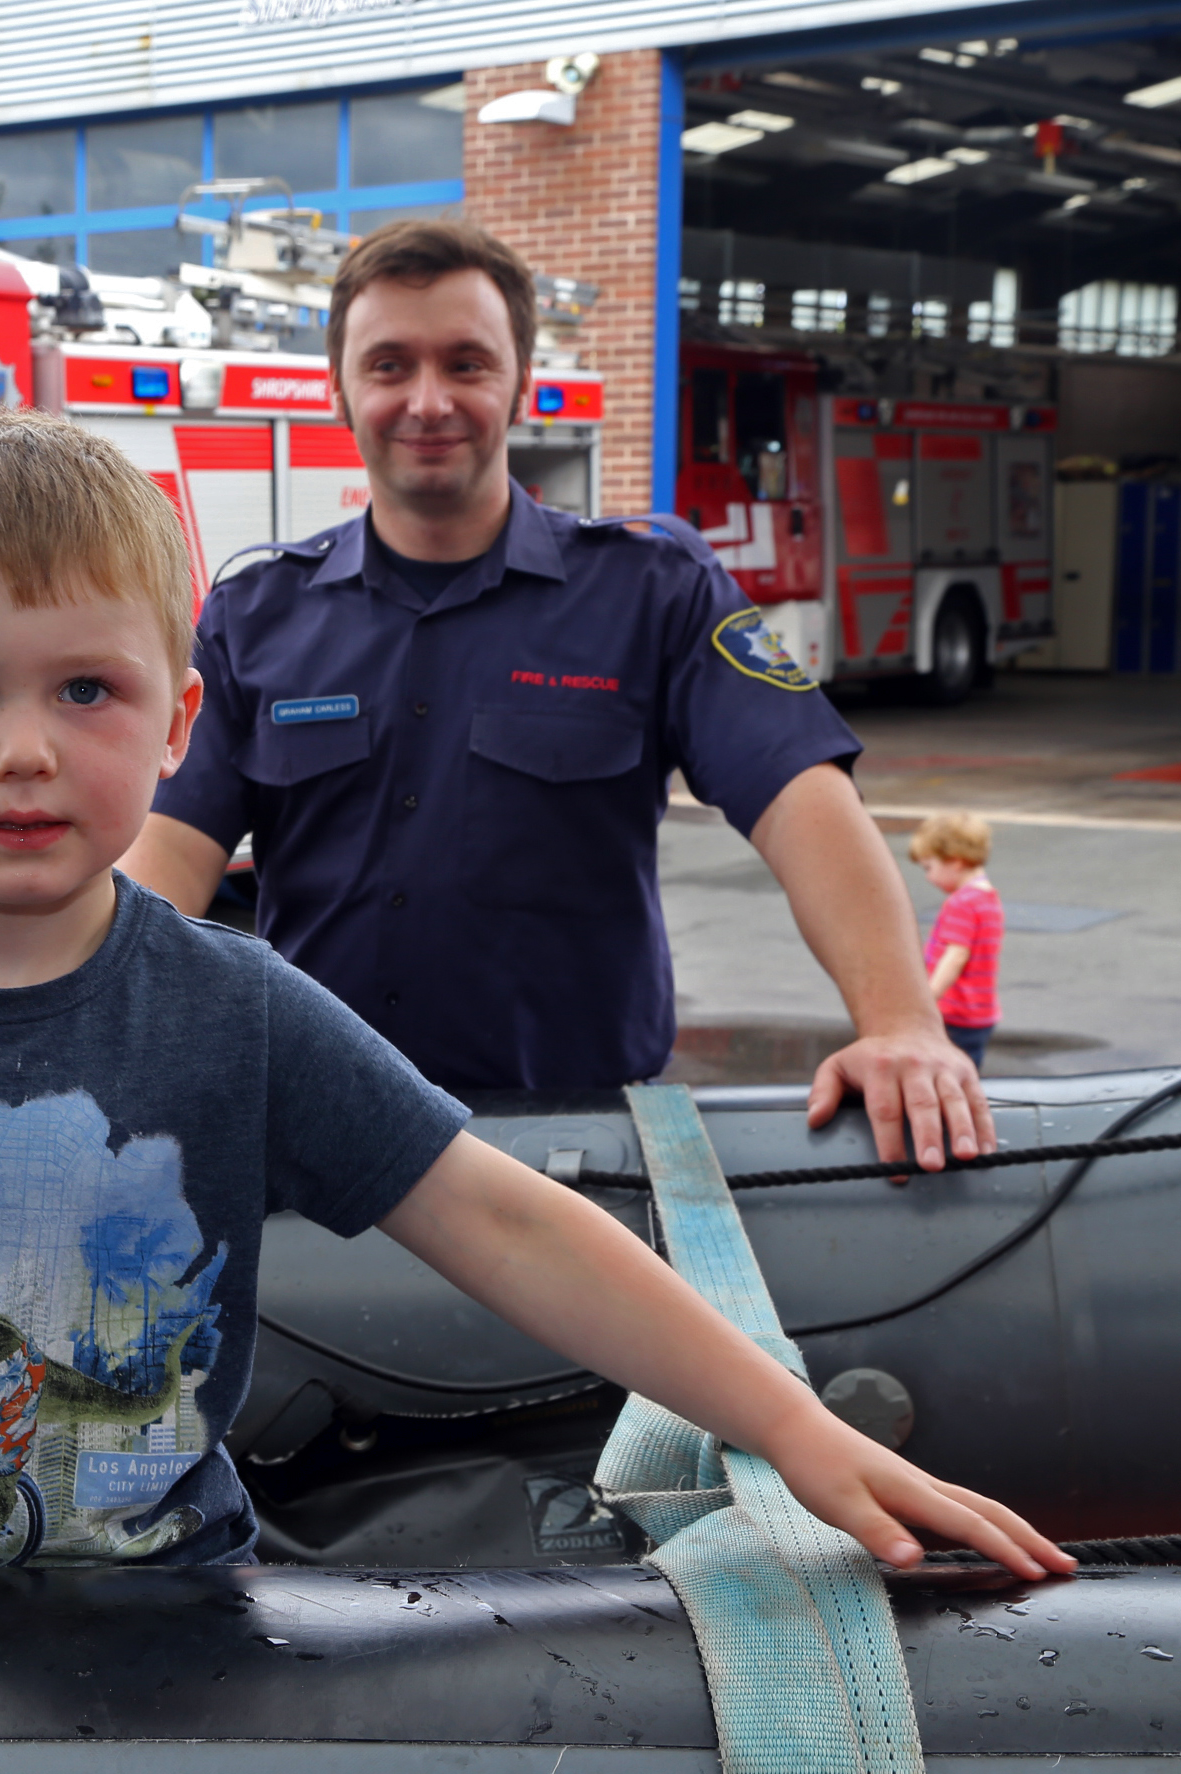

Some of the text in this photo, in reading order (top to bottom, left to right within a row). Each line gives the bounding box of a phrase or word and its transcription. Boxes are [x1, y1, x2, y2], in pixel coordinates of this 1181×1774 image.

[250, 376, 327, 402] SHROPSHIRE
[510, 670, 545, 686] FIRE
[561, 674, 620, 692] RESCUE
[88, 1456, 192, 1480] Los Angeles
[108, 1480, 135, 1492] CITY
[539, 1532, 617, 1550] ZODIAC
